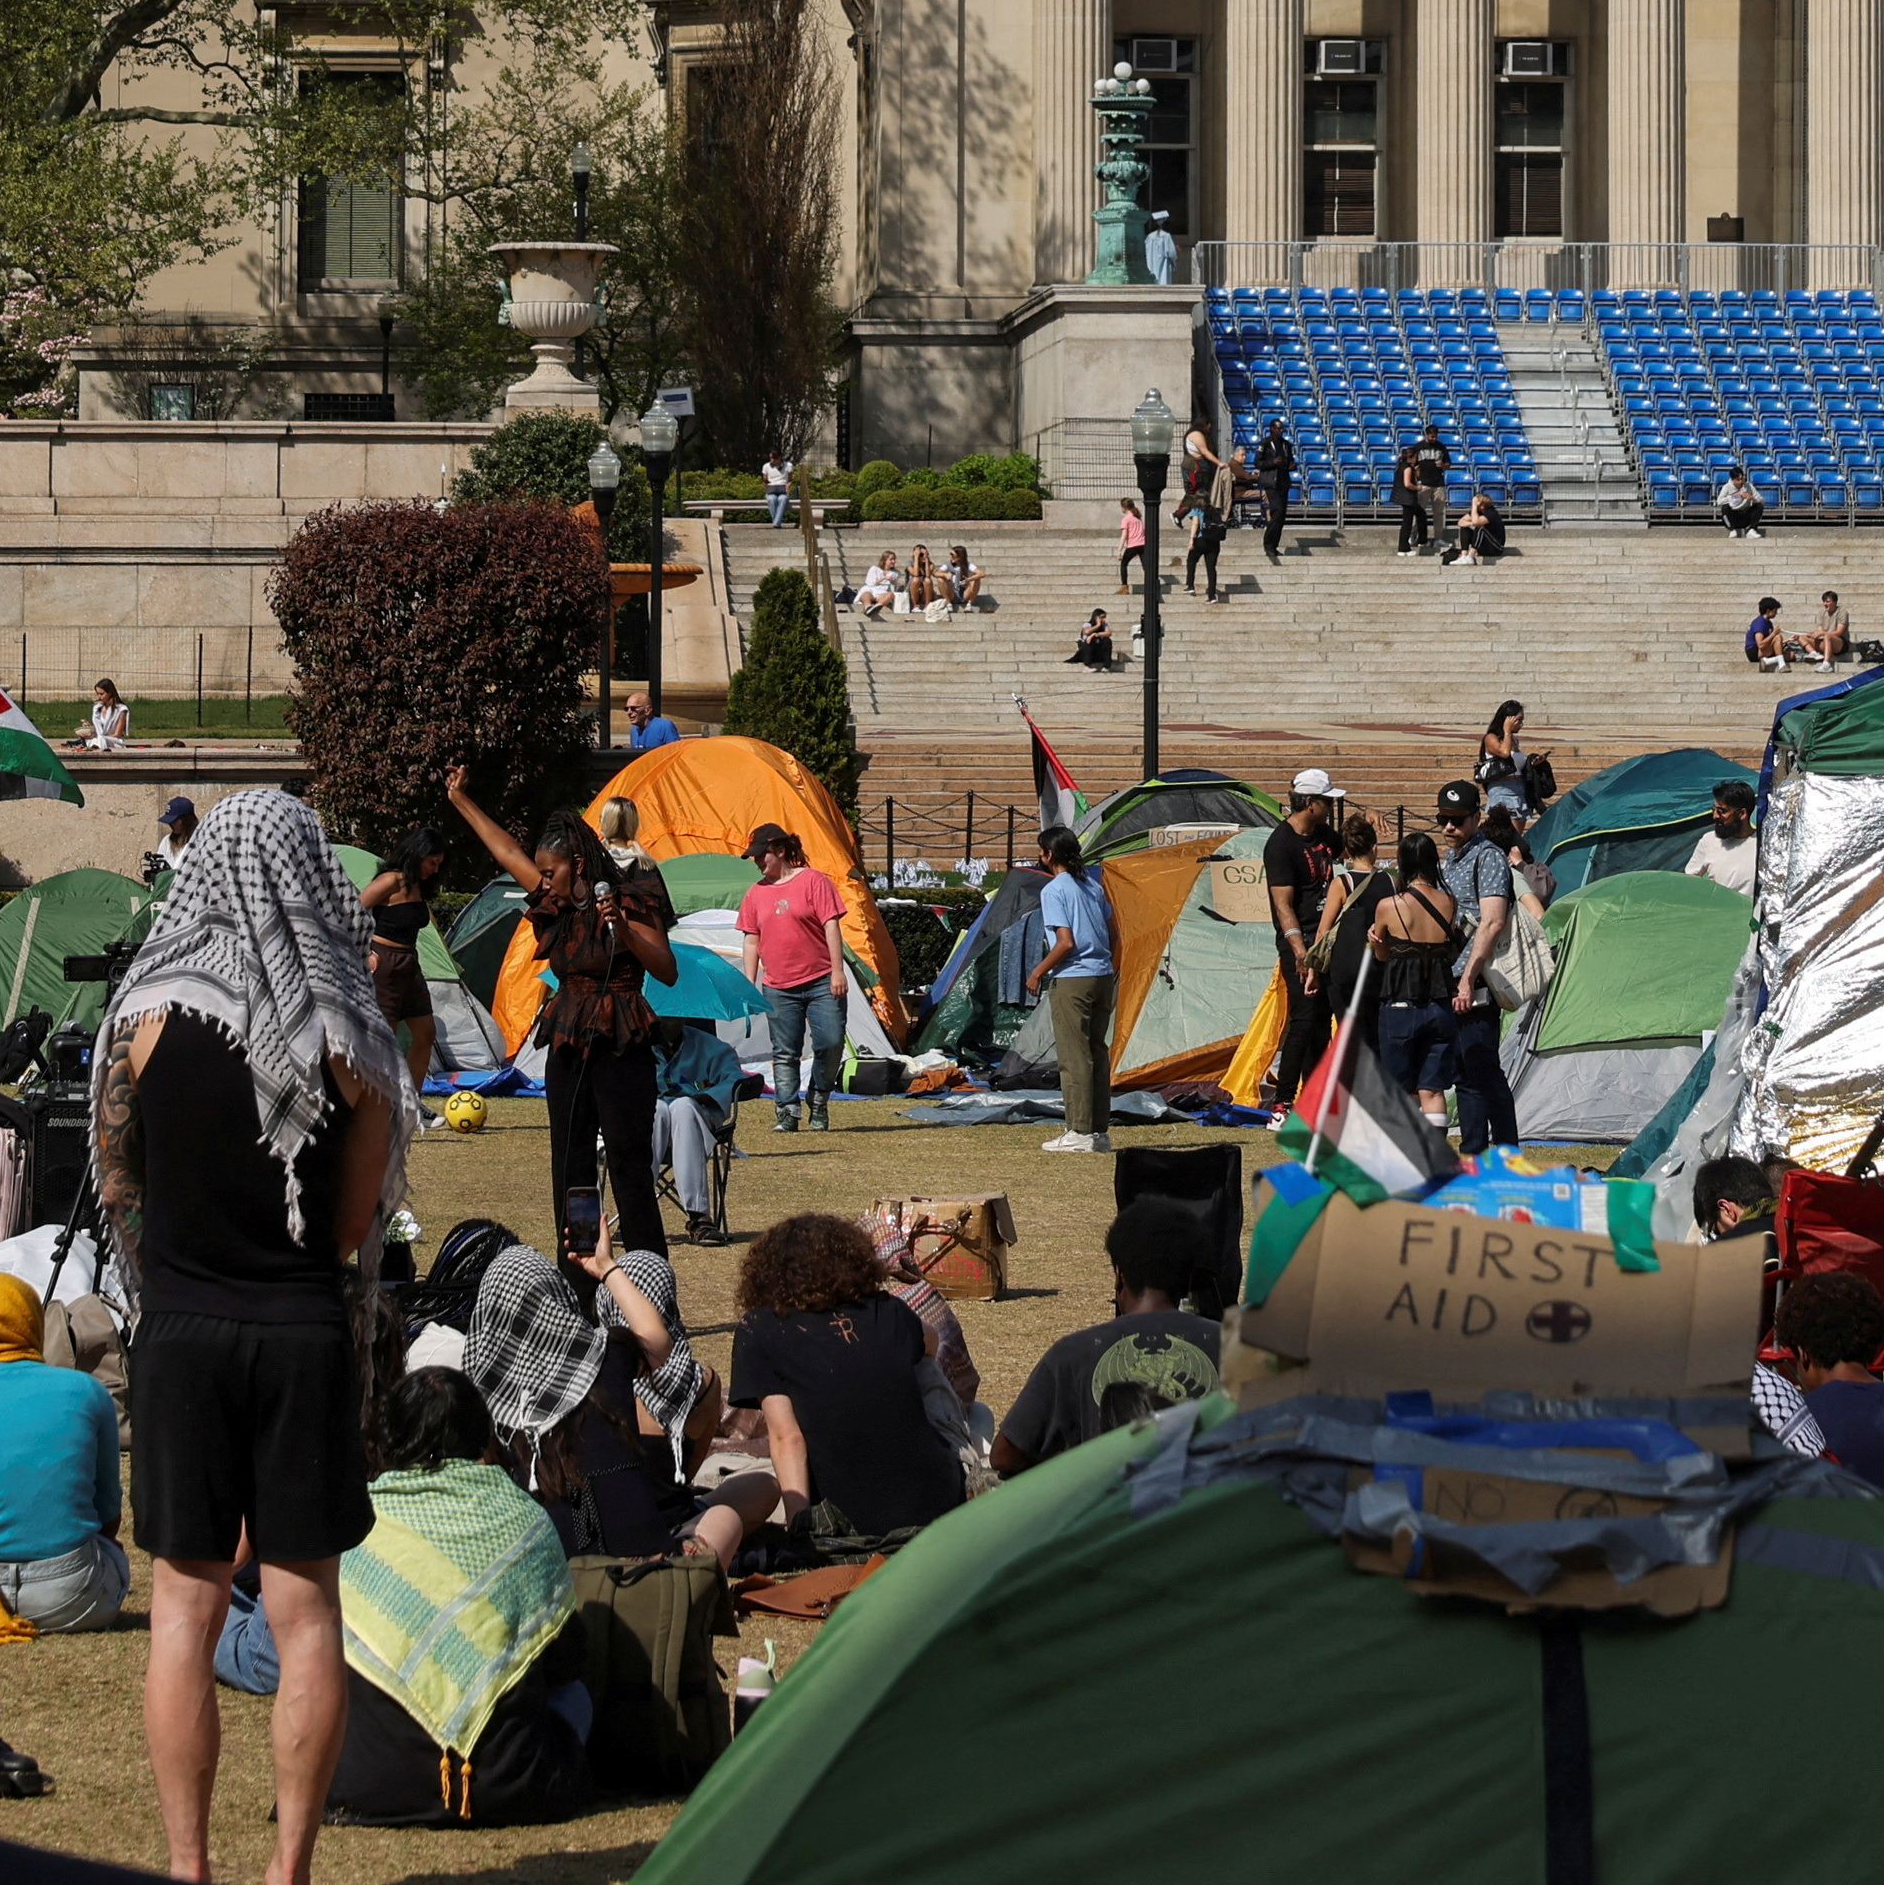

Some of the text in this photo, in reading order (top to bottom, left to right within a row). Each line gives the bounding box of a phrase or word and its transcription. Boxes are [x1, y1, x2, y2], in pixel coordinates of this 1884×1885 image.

[1149, 830, 1181, 846] LOST
[1398, 1219, 1616, 1288] FIRST
[1384, 1281, 1498, 1337] AID
[1434, 1480, 1507, 1519] NO
